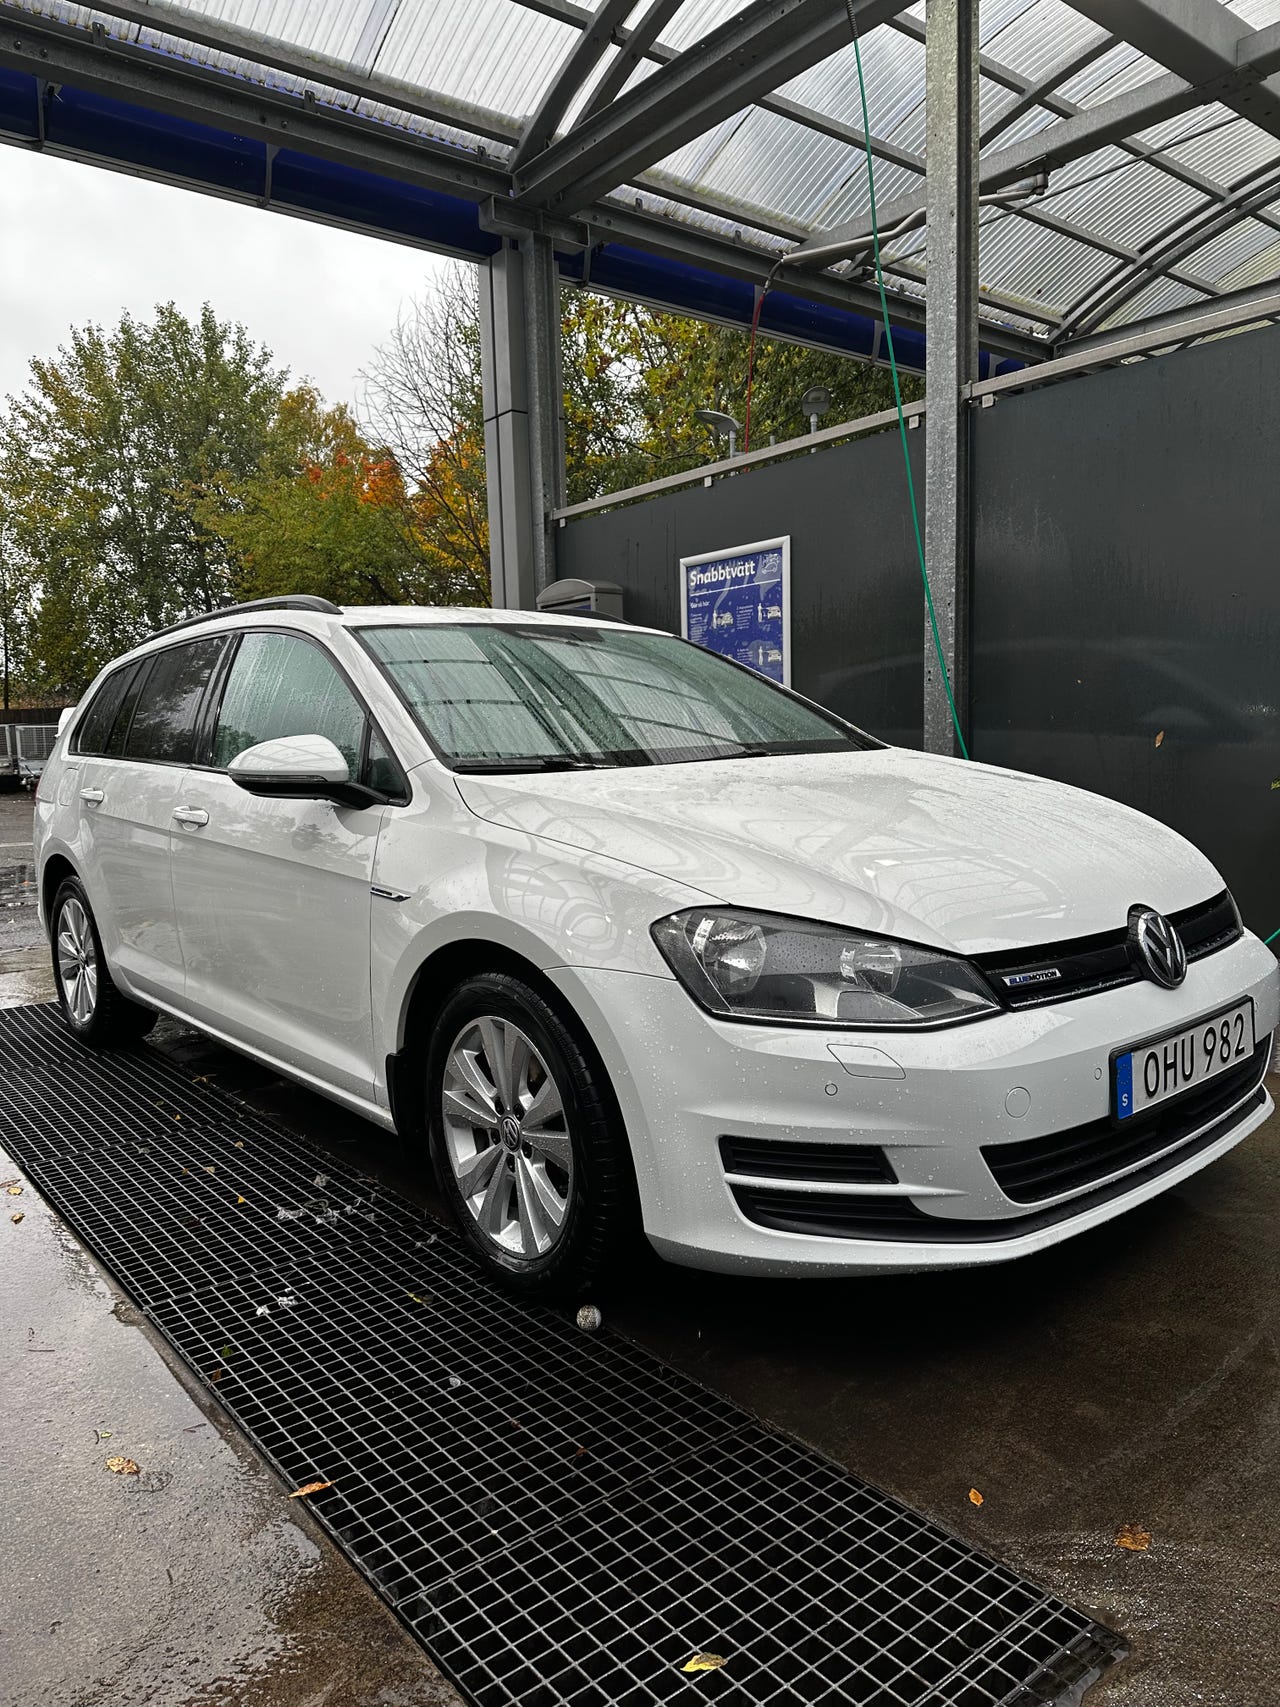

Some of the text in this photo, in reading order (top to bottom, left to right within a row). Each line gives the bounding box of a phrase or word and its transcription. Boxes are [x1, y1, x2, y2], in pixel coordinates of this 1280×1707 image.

[690, 560, 756, 586] Snabbtvätt
[1009, 970, 1057, 985] BLUEMOTION
[1144, 1013, 1246, 1099] OHU 982
[1121, 1093, 1129, 1107] S
